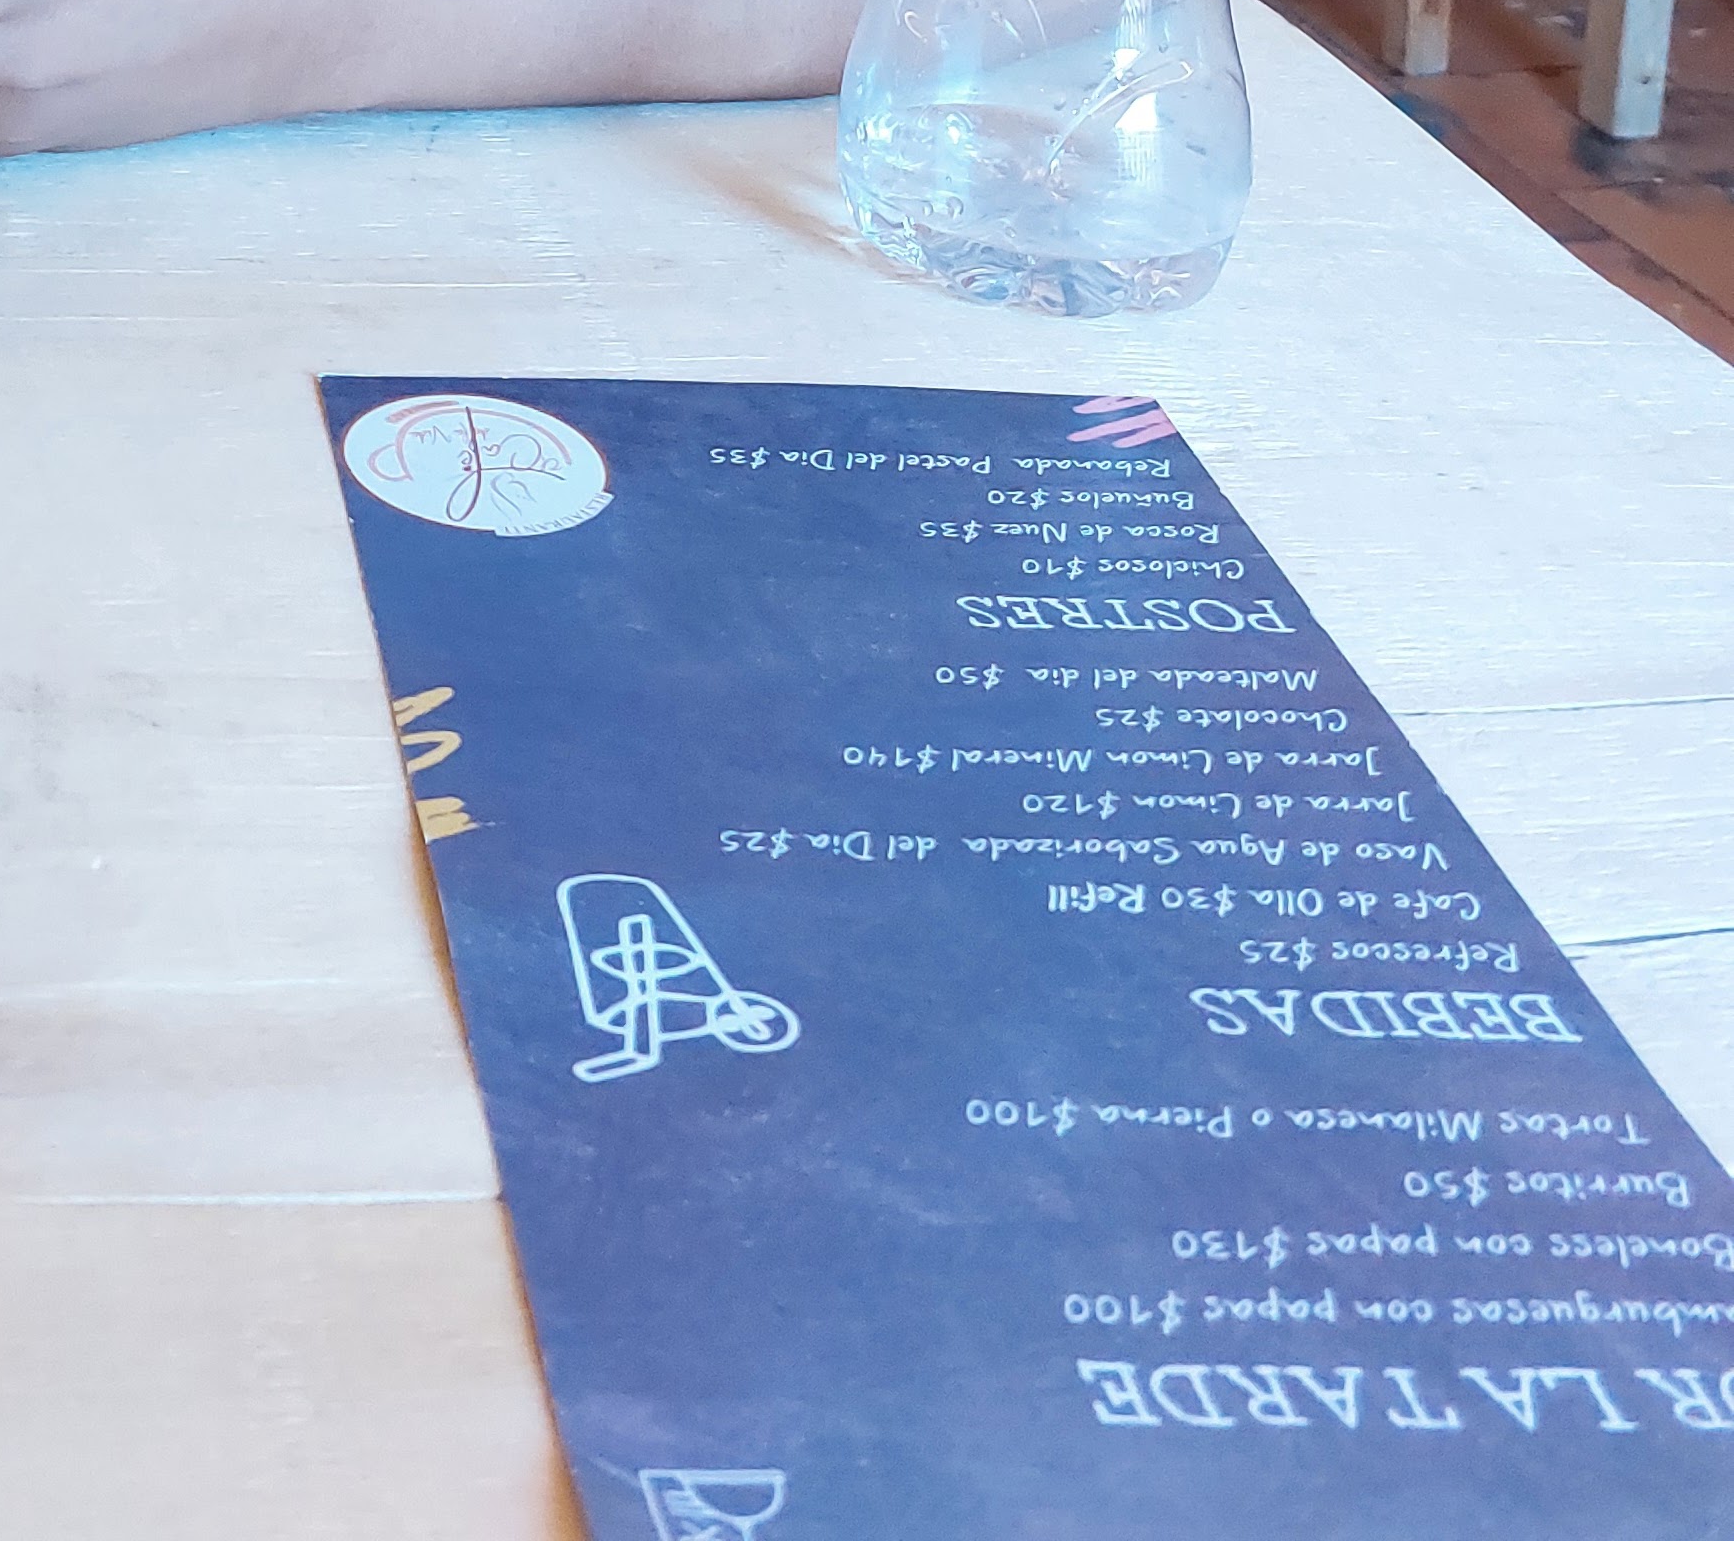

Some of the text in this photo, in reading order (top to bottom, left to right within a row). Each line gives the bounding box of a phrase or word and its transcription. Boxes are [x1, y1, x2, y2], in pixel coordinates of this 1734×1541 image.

[709, 446, 1171, 479] Rebanada Pastel del Dia $35
[987, 486, 1195, 511] Buñuelos $20
[919, 519, 1220, 545] Rosca de Nuez $35
[1021, 554, 1245, 581] Chiclosos $10
[955, 594, 1297, 634] POSTRES
[935, 663, 1319, 692] Malteada del dia $50
[1095, 704, 1349, 734] Chocolate $25
[842, 743, 1383, 777] Jarra de Limon Mineral $140
[1022, 789, 1415, 823] Jarra de Limon $120
[719, 826, 1450, 871] Vaso de Agua Saborizada del Dia $25
[1047, 880, 1482, 922] Cafe de Olla $30 Refill
[1239, 936, 1520, 974] Refrescos $25
[1188, 987, 1584, 1044] BEBIDAS
[965, 1097, 1651, 1145] Tortas Milanesa o Pierna $100
[1403, 1166, 1691, 1208] Burritos $50
[1171, 1222, 1734, 1272] Boneless con papas $130
[1063, 1289, 1186, 1336] $100
[1203, 1286, 1339, 1324] papas
[1354, 1298, 1435, 1323] con
[1075, 1358, 1464, 1431] TARDE
[1458, 1366, 1640, 1432] LA
